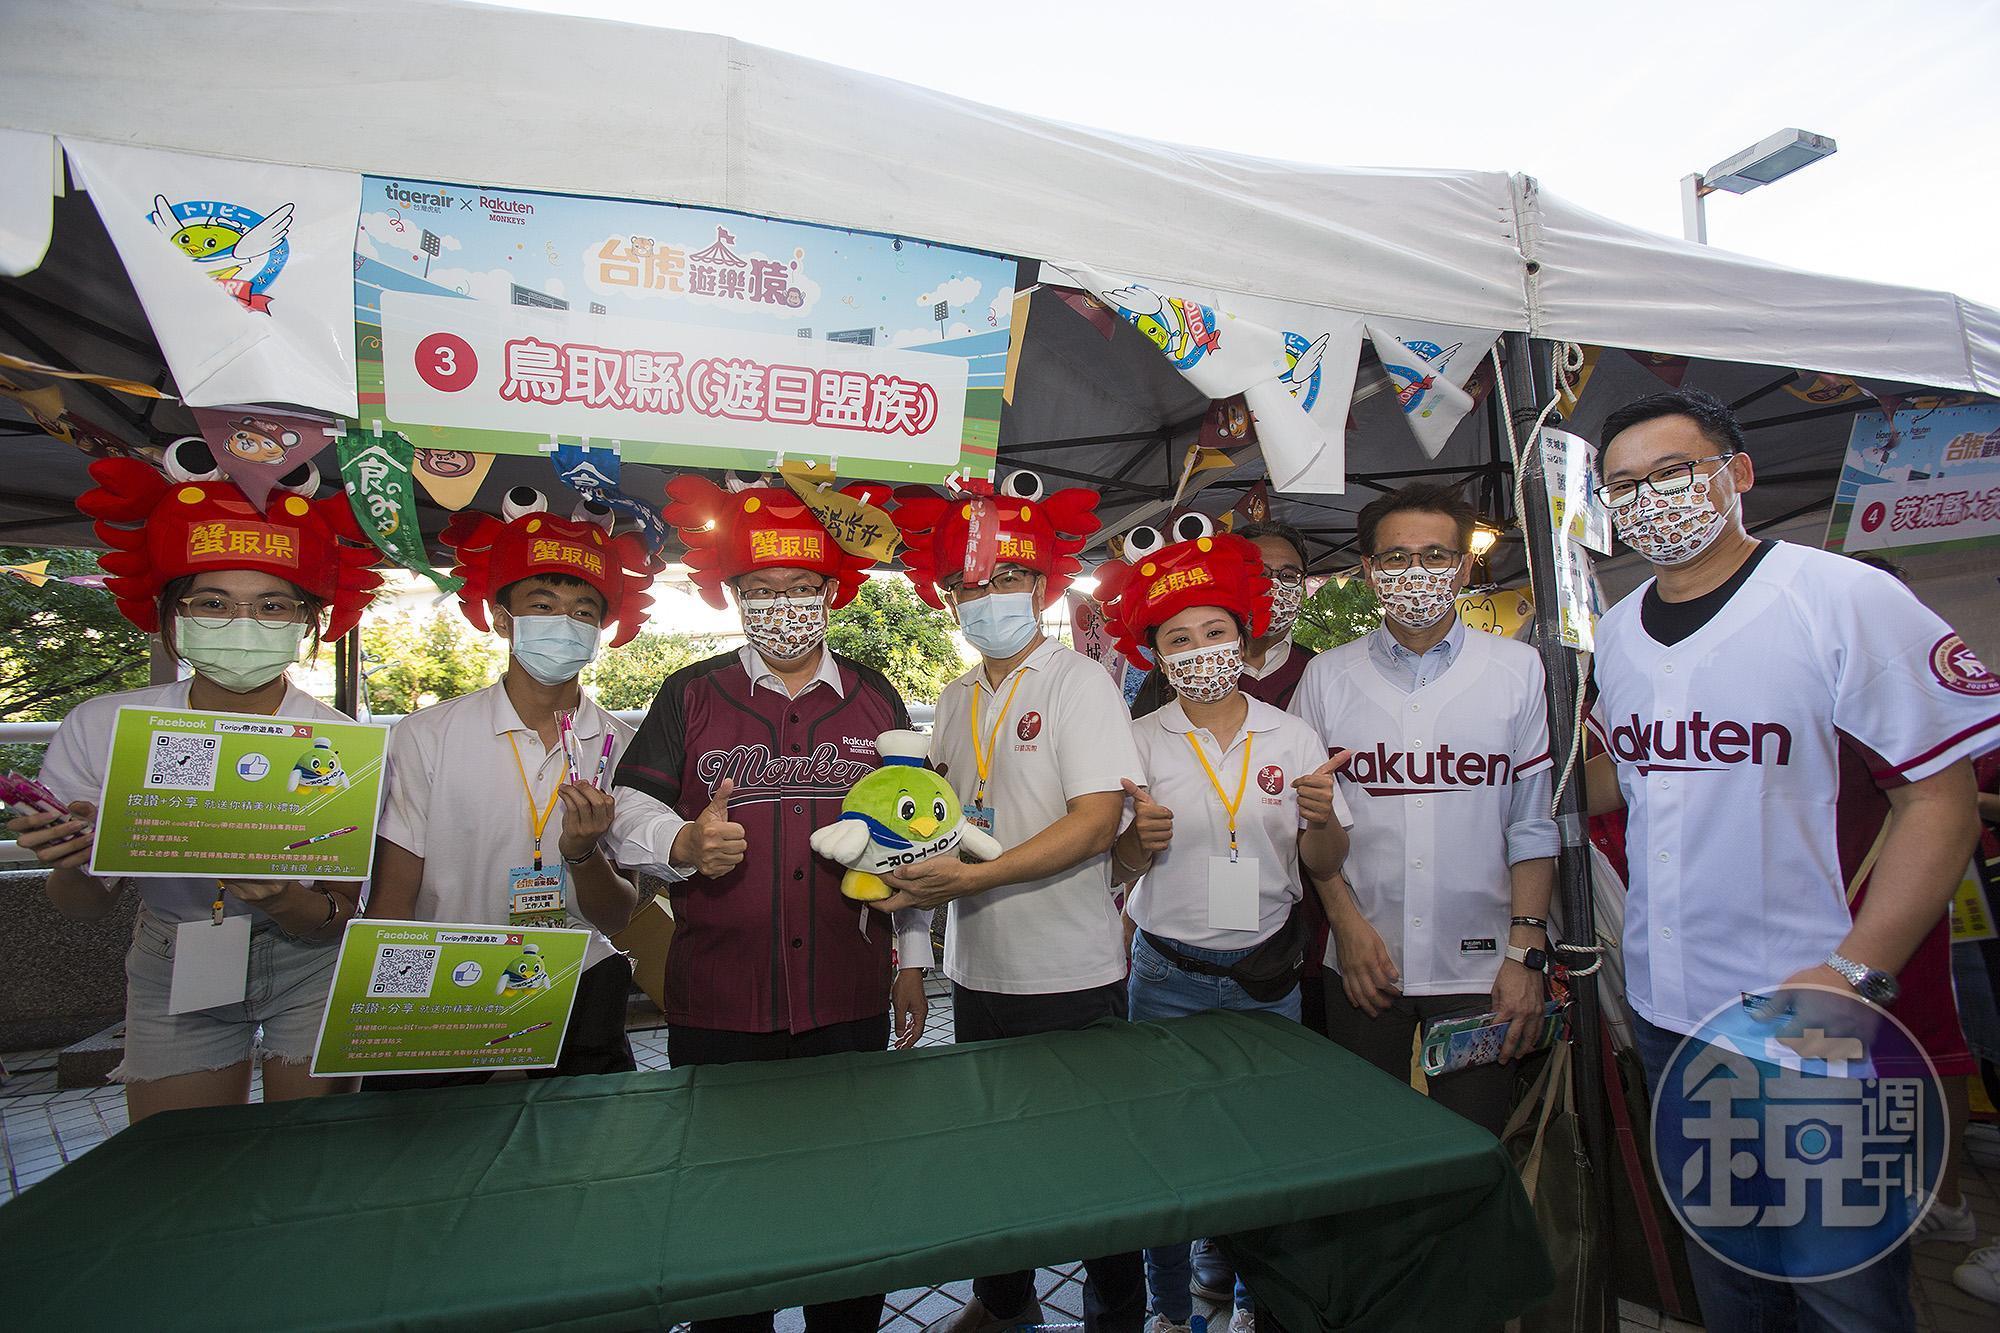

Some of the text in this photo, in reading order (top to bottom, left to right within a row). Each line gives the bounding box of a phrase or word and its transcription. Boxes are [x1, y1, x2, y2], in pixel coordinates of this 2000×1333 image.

[385, 183, 454, 209] tigerair
[479, 195, 535, 215] Rakuten
[183, 203, 251, 219] トリピー
[489, 214, 526, 226] MONKEYS
[433, 346, 458, 377] 3
[1867, 508, 1879, 524] 4
[190, 523, 294, 559] 蟹取県
[753, 531, 821, 559] 蟹取県
[998, 538, 1037, 560] 取県
[532, 539, 602, 575] 蟹取県
[149, 716, 207, 729] Facebook
[842, 736, 876, 748] Rakute
[127, 793, 199, 808] 按讚+分享
[875, 831, 958, 867] TOTTORI
[376, 930, 429, 941] Facebook
